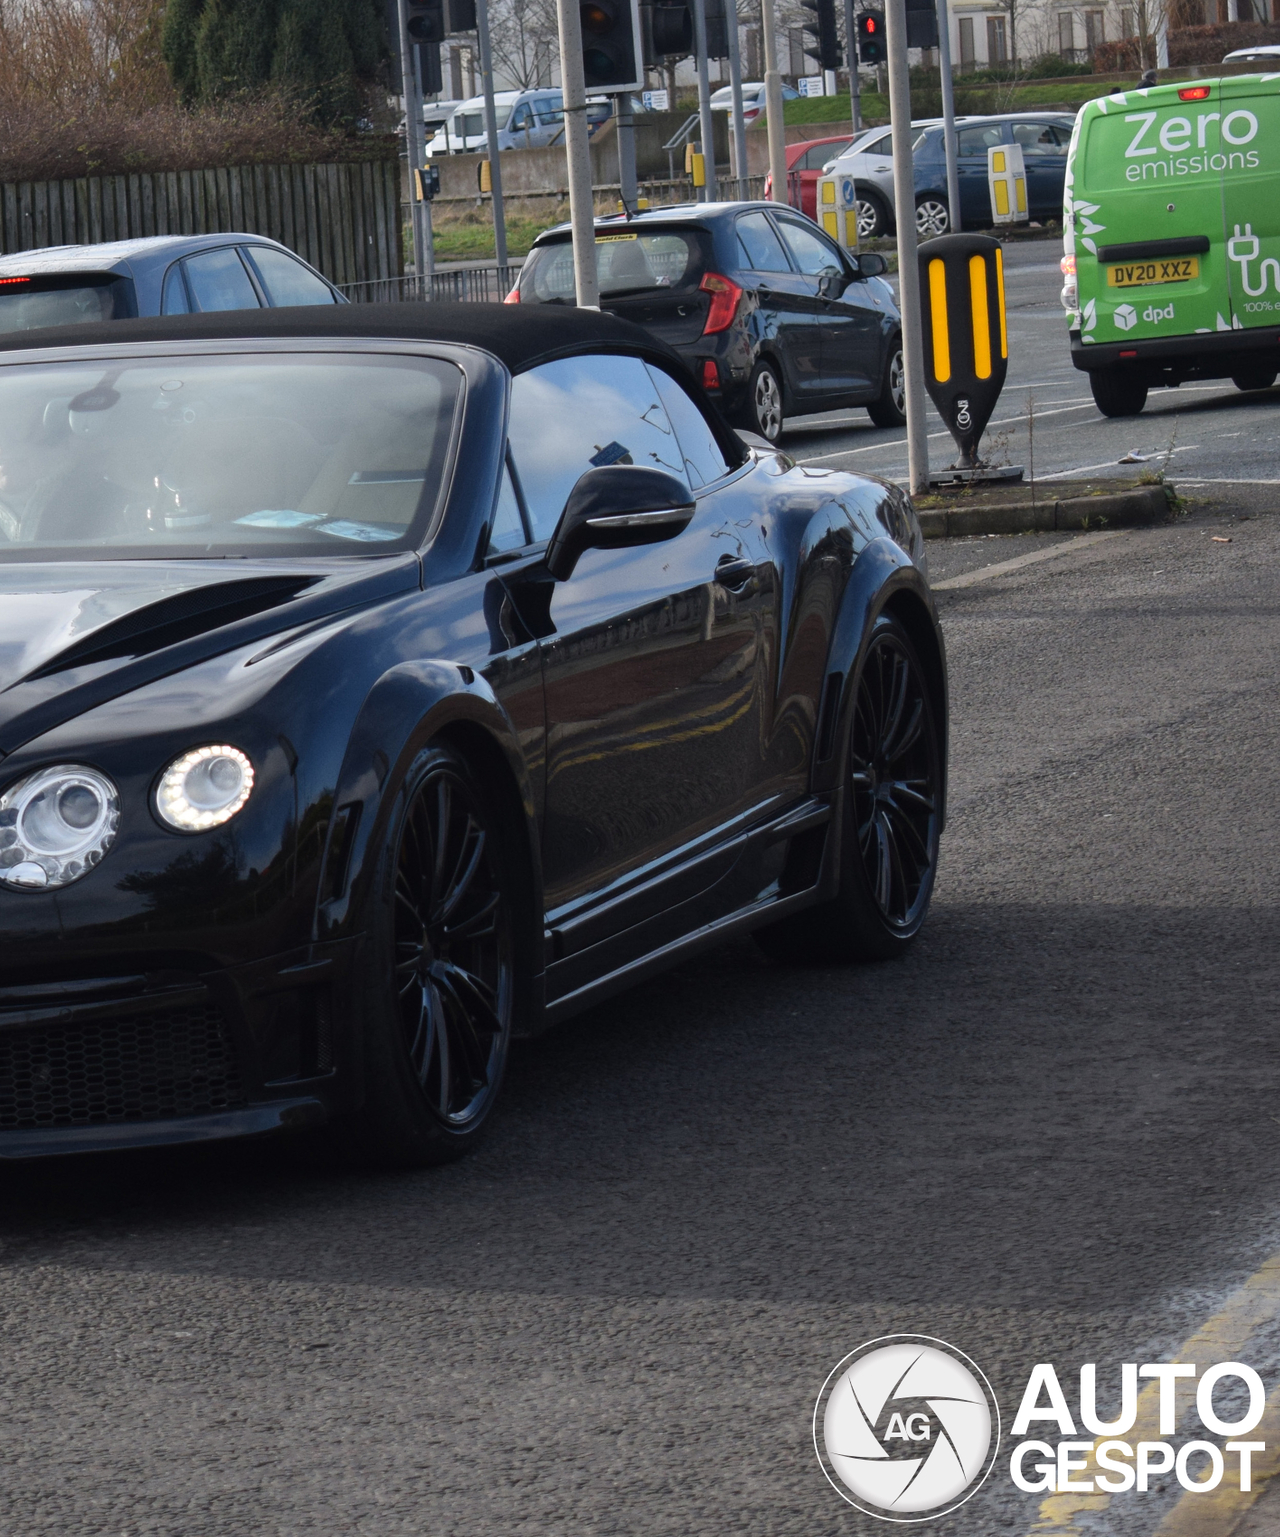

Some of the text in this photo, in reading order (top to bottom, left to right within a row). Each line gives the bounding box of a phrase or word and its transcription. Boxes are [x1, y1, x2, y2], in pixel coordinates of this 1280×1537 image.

[1124, 109, 1259, 158] Zero
[1125, 150, 1260, 182] emissions
[1114, 260, 1192, 283] DV20 XXZ
[1142, 303, 1175, 325] dpd
[1242, 301, 1274, 313] 100%
